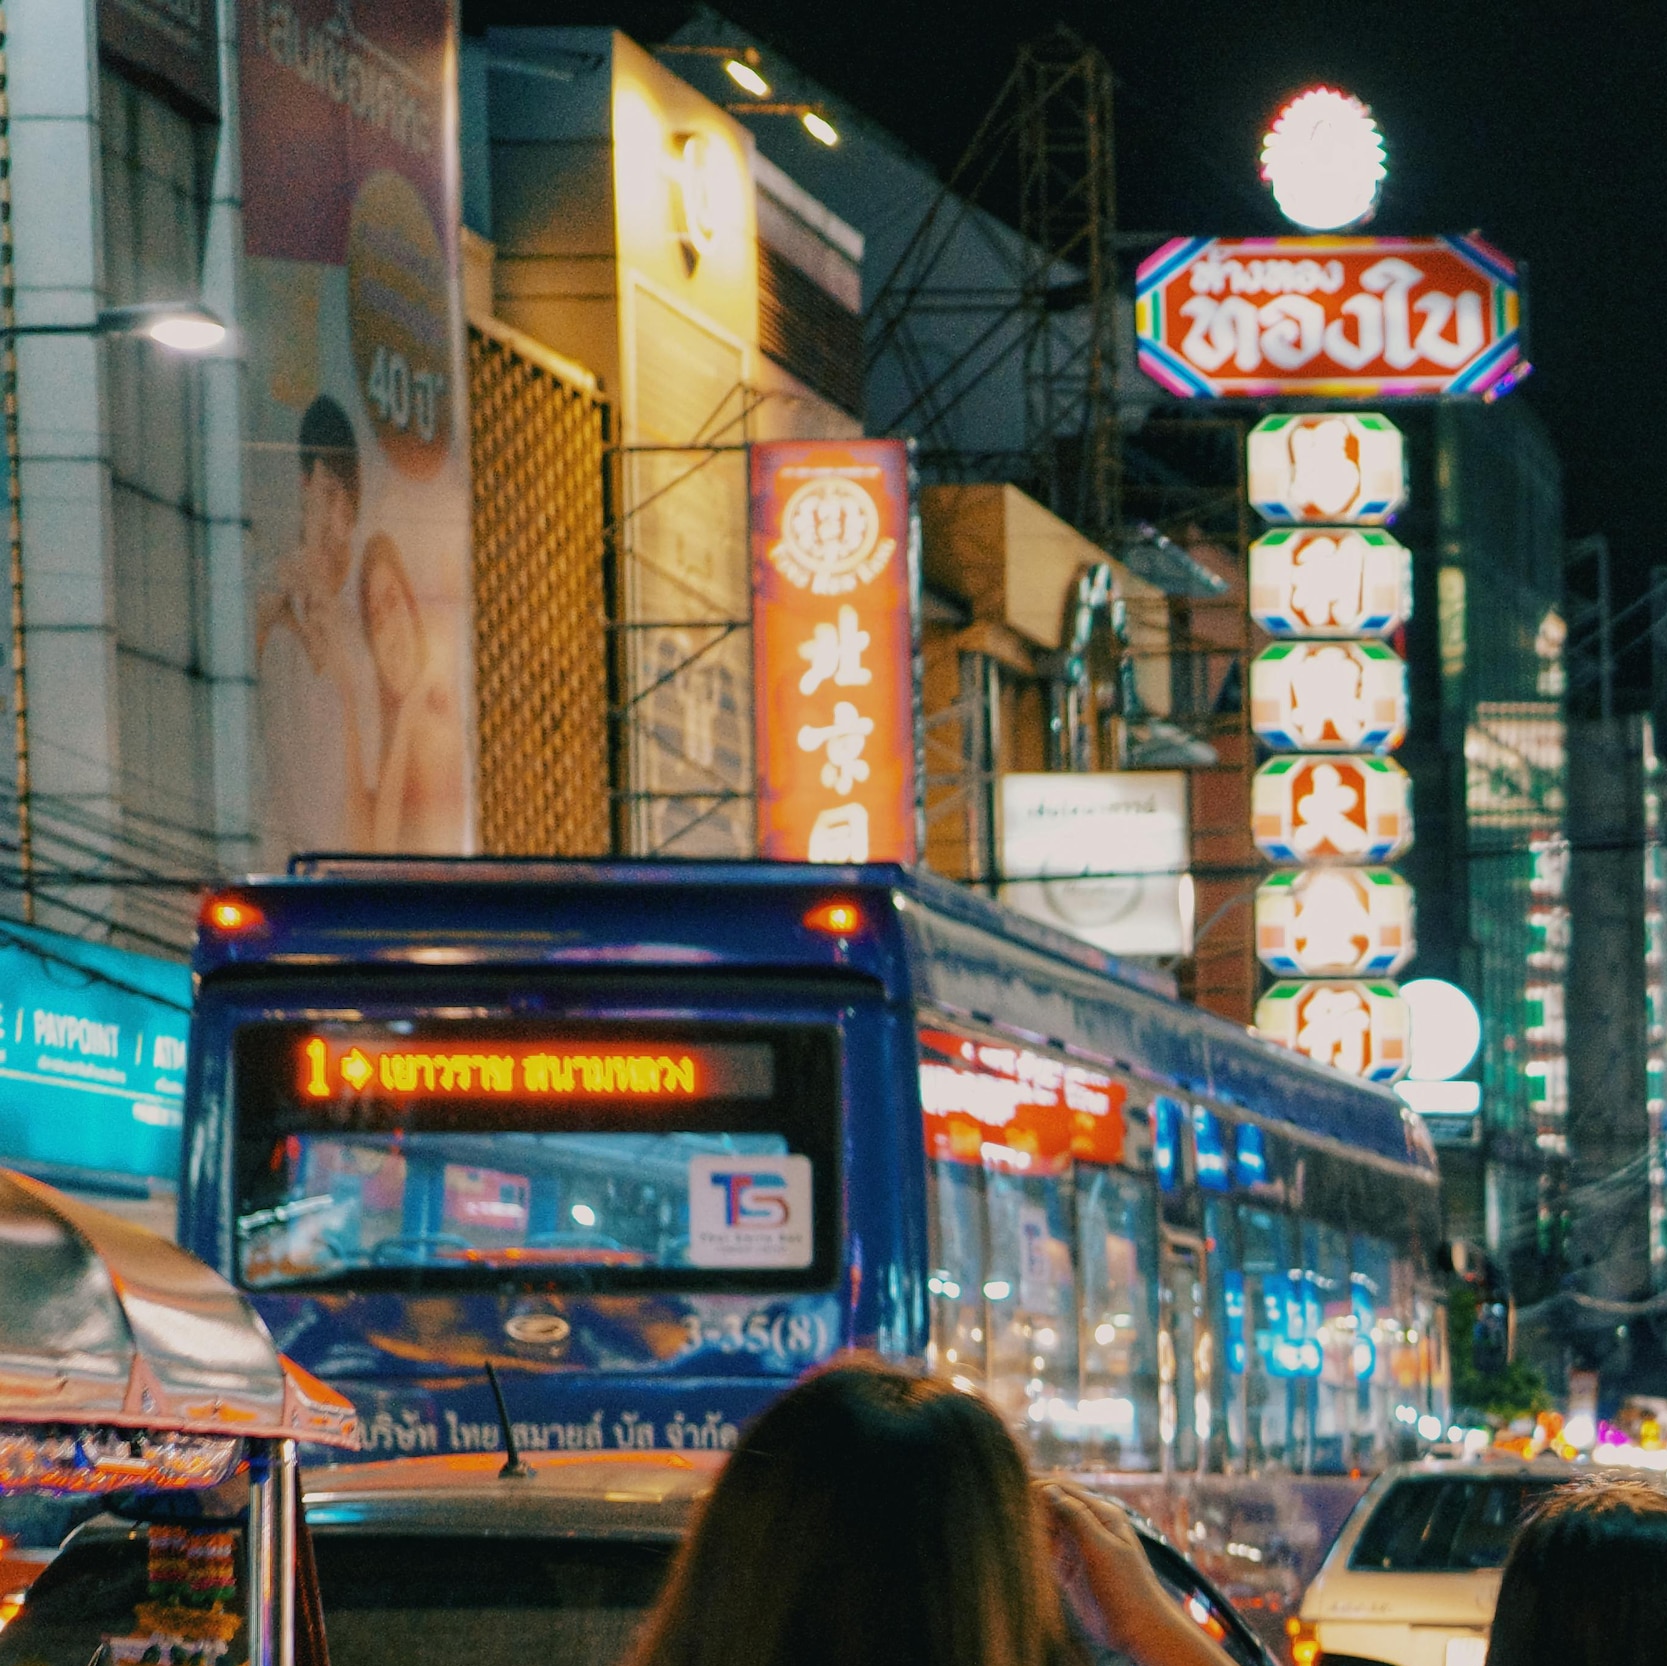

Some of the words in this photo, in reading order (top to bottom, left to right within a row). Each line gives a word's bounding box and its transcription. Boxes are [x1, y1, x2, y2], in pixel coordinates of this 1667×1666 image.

[1180, 257, 1484, 372] ทองใบ
[34, 1008, 120, 1059] PAYPOINT
[306, 1038, 330, 1097] 1
[521, 1052, 696, 1094] สนามหลวง
[682, 1312, 828, 1361] 3-35(8)
[356, 1409, 437, 1451] บริษัท
[444, 1408, 499, 1451] ไทย
[511, 1410, 604, 1451] สมายล์
[613, 1411, 655, 1450] บัส
[666, 1410, 740, 1451] จำกัด
